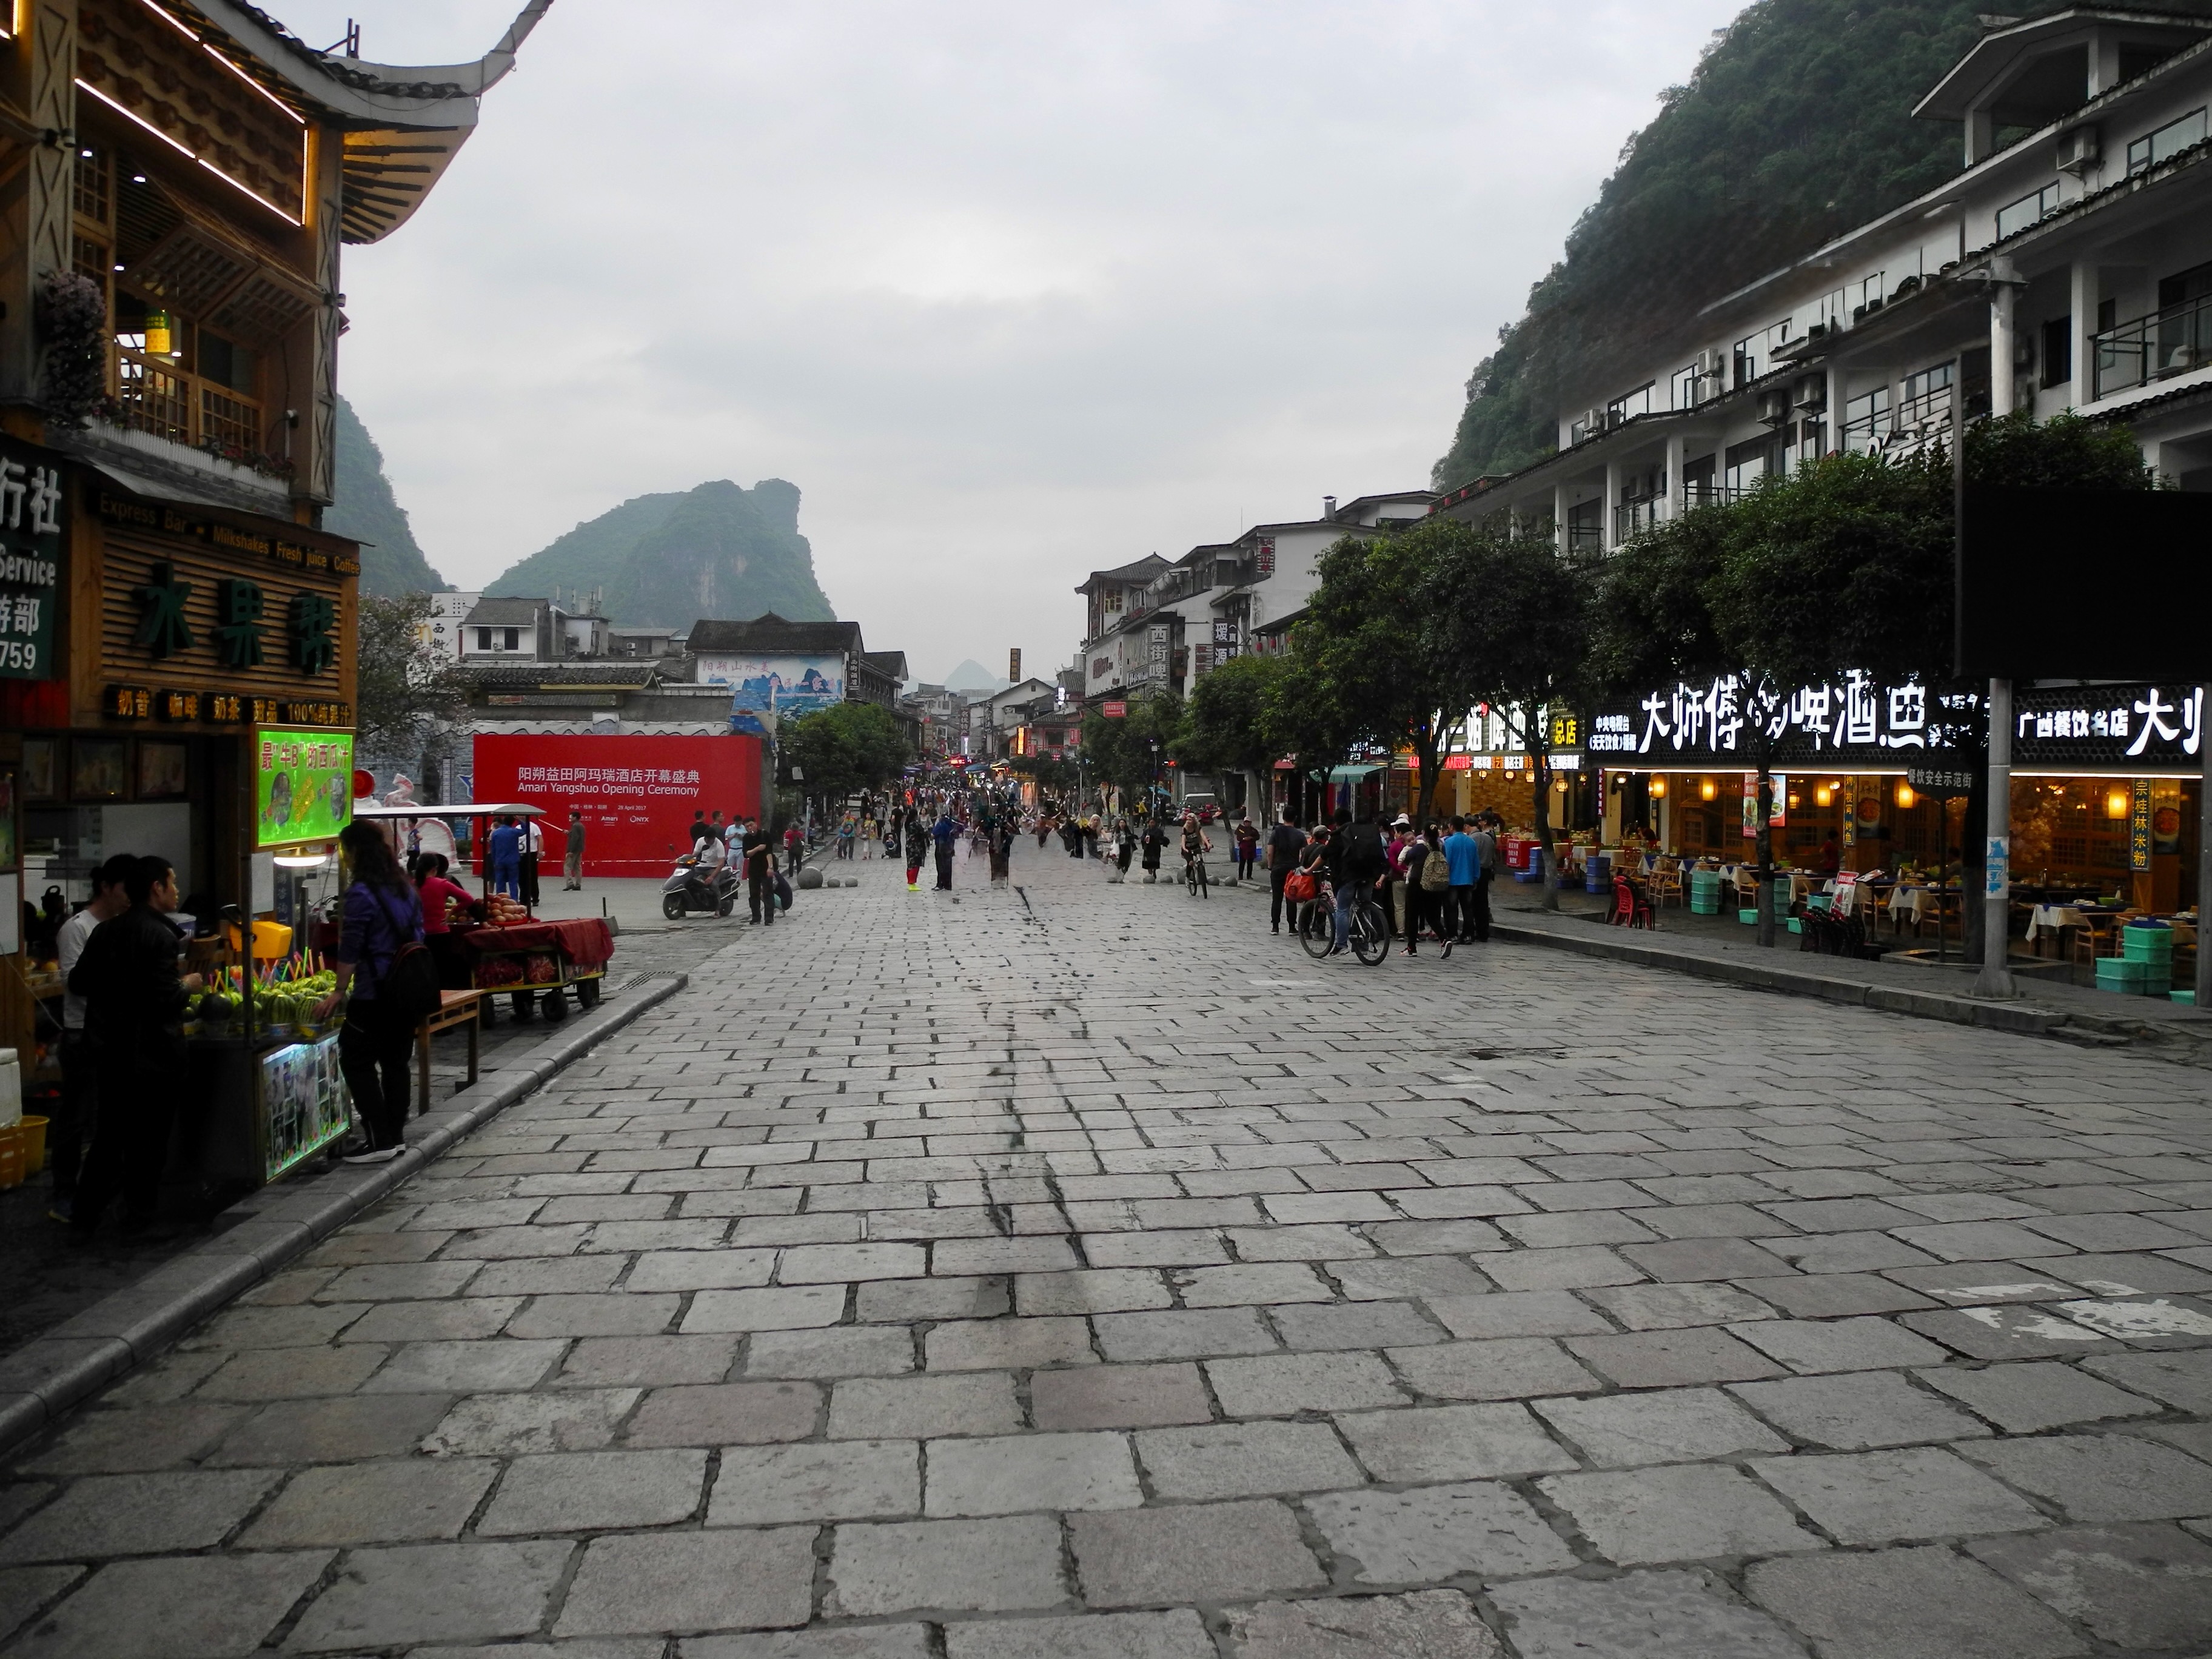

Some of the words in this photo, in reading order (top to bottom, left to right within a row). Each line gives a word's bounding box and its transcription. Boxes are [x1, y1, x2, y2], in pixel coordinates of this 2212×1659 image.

[0, 456, 61, 536] 行社
[100, 492, 156, 525] Express
[164, 509, 189, 534] Bar
[213, 525, 270, 555] Milkshakes
[276, 541, 302, 562] Fresh
[306, 548, 327, 568] juice
[333, 555, 361, 575] Coffee
[130, 561, 335, 675] 水果帮
[702, 660, 771, 674] 阳朔山水美
[117, 689, 150, 718] 奶昔
[169, 692, 198, 720] 咖啡
[213, 696, 241, 722] 奶茶
[252, 699, 278, 723] 甜品
[1554, 719, 1577, 745] 总店
[2019, 707, 2129, 739] 广西餐饮名店
[517, 782, 547, 793] Amari
[550, 782, 599, 796] Yangshuo
[602, 783, 645, 797] Opening
[648, 784, 700, 798] Ceremony
[518, 766, 700, 784] 阳朔益田阿玛瑞酒店开幕盛典
[1908, 768, 1972, 788] 餐饮安全示范街
[2133, 780, 2148, 866] 宗桂林米粉
